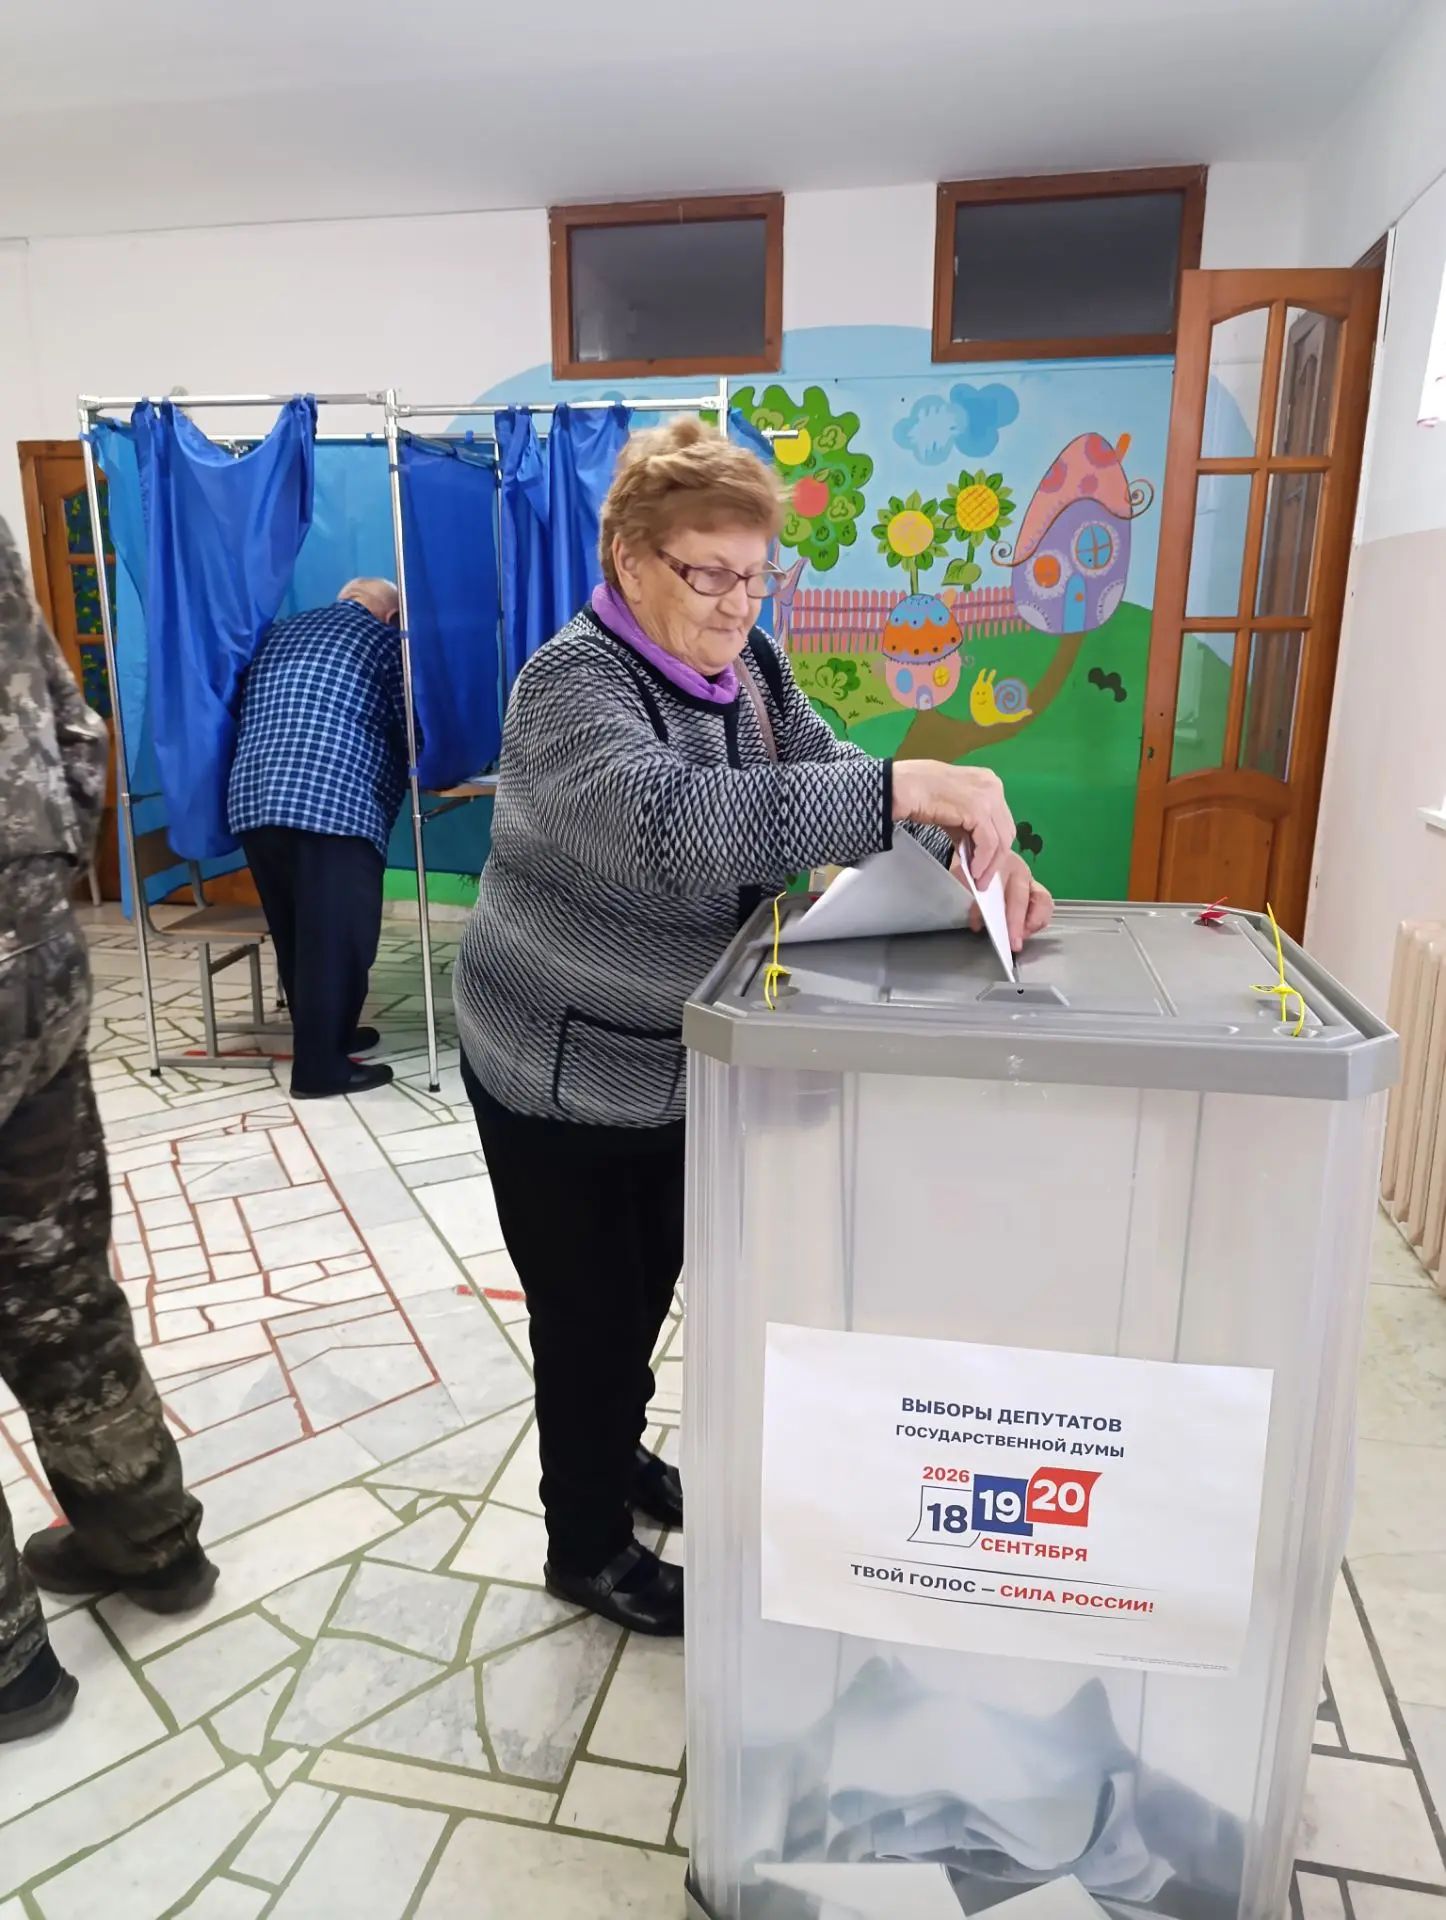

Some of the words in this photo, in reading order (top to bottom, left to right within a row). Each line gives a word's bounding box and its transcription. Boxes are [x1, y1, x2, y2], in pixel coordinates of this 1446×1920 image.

[902, 1397, 992, 1421] ВЫБОРЫ
[997, 1408, 1122, 1433] ДЕПУТАТОВ
[896, 1424, 1067, 1453] ГОСУДАРСТВЕННОЙ
[1069, 1442, 1125, 1458] ДУМЫ
[922, 1466, 970, 1483] 2026
[926, 1502, 968, 1534] 18
[978, 1489, 1022, 1523] 19
[1031, 1478, 1086, 1514] 20
[980, 1537, 1088, 1562] СЕНТЯБРЯ
[850, 1563, 904, 1583] ТВОЙ
[909, 1572, 977, 1593] ГОЛОС
[1000, 1584, 1056, 1603] СИЛА
[1061, 1591, 1154, 1613] РОССИИ!
